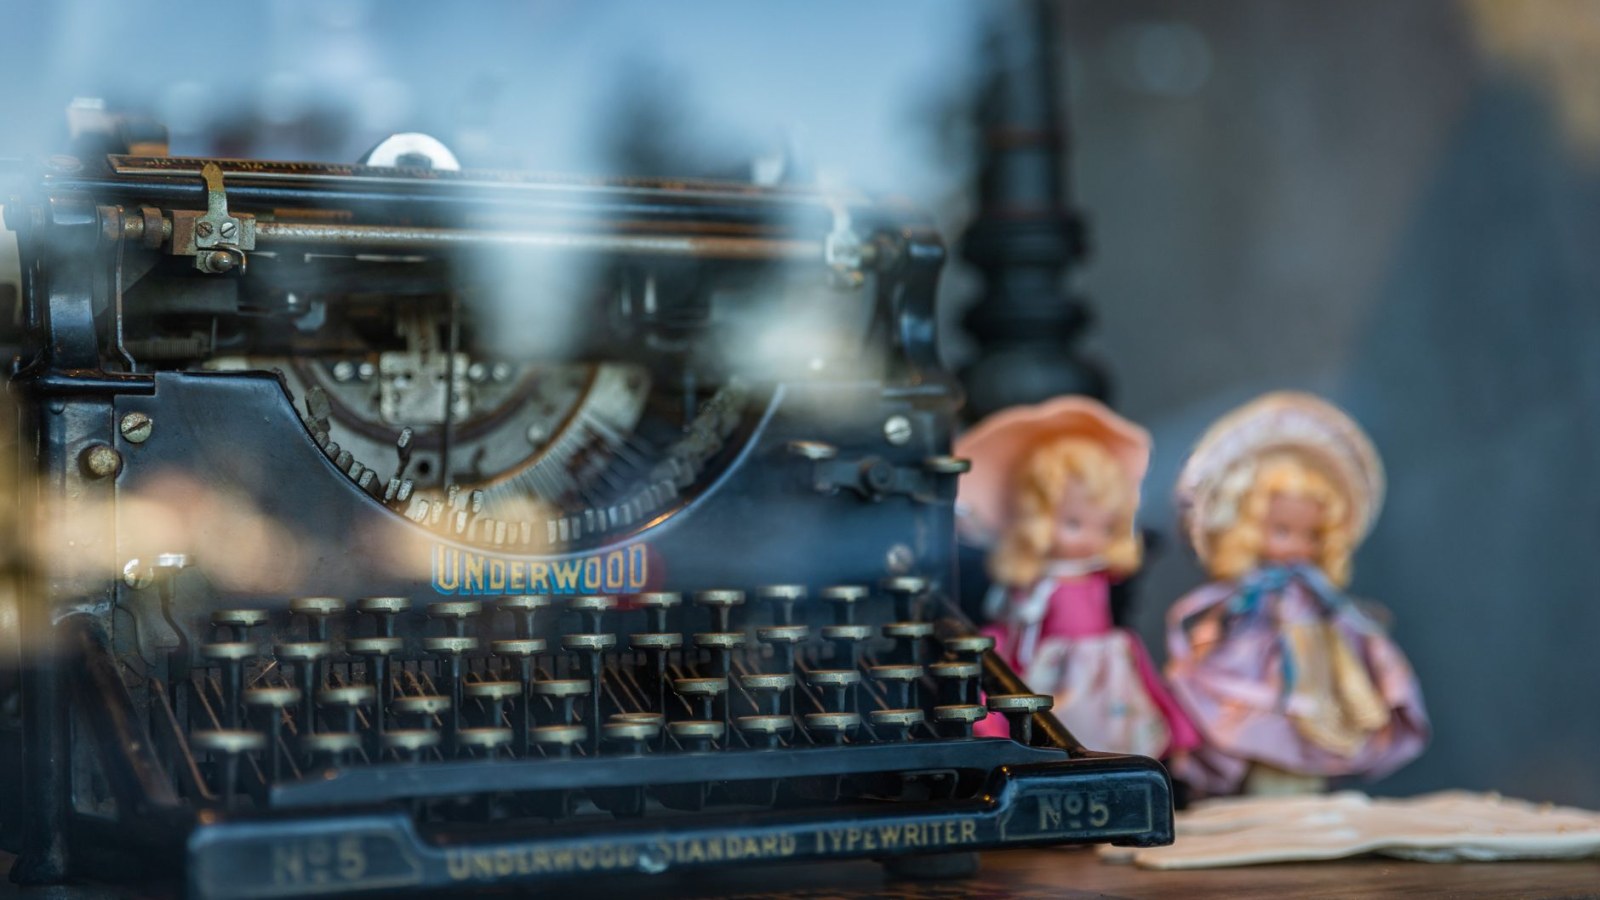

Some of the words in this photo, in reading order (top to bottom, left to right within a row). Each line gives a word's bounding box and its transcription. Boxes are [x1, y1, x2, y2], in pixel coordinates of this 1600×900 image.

[432, 543, 648, 595] UNDERWOOD
[447, 839, 637, 881] UNDERWOOD
[815, 819, 977, 854] TYPEWRITER
